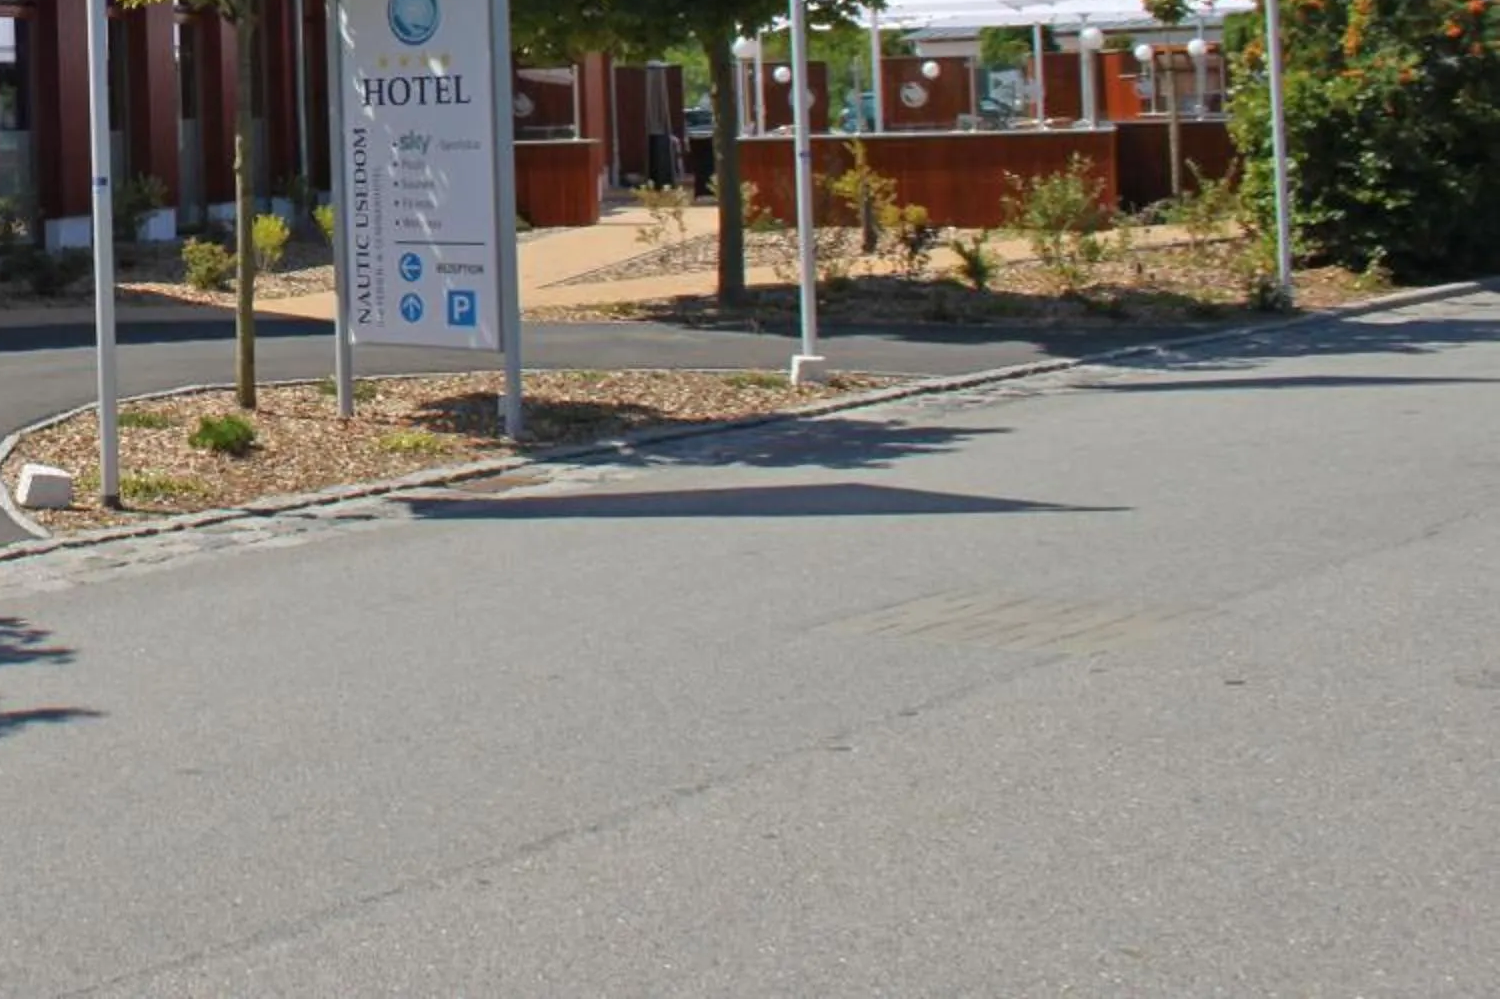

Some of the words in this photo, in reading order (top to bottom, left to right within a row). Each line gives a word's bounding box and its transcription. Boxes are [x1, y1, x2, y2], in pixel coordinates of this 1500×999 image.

[362, 74, 472, 106] HOTEL
[399, 129, 432, 155] sky
[353, 128, 369, 227] USEDOM
[356, 233, 372, 325] NAUTIC
[453, 296, 470, 321] P
